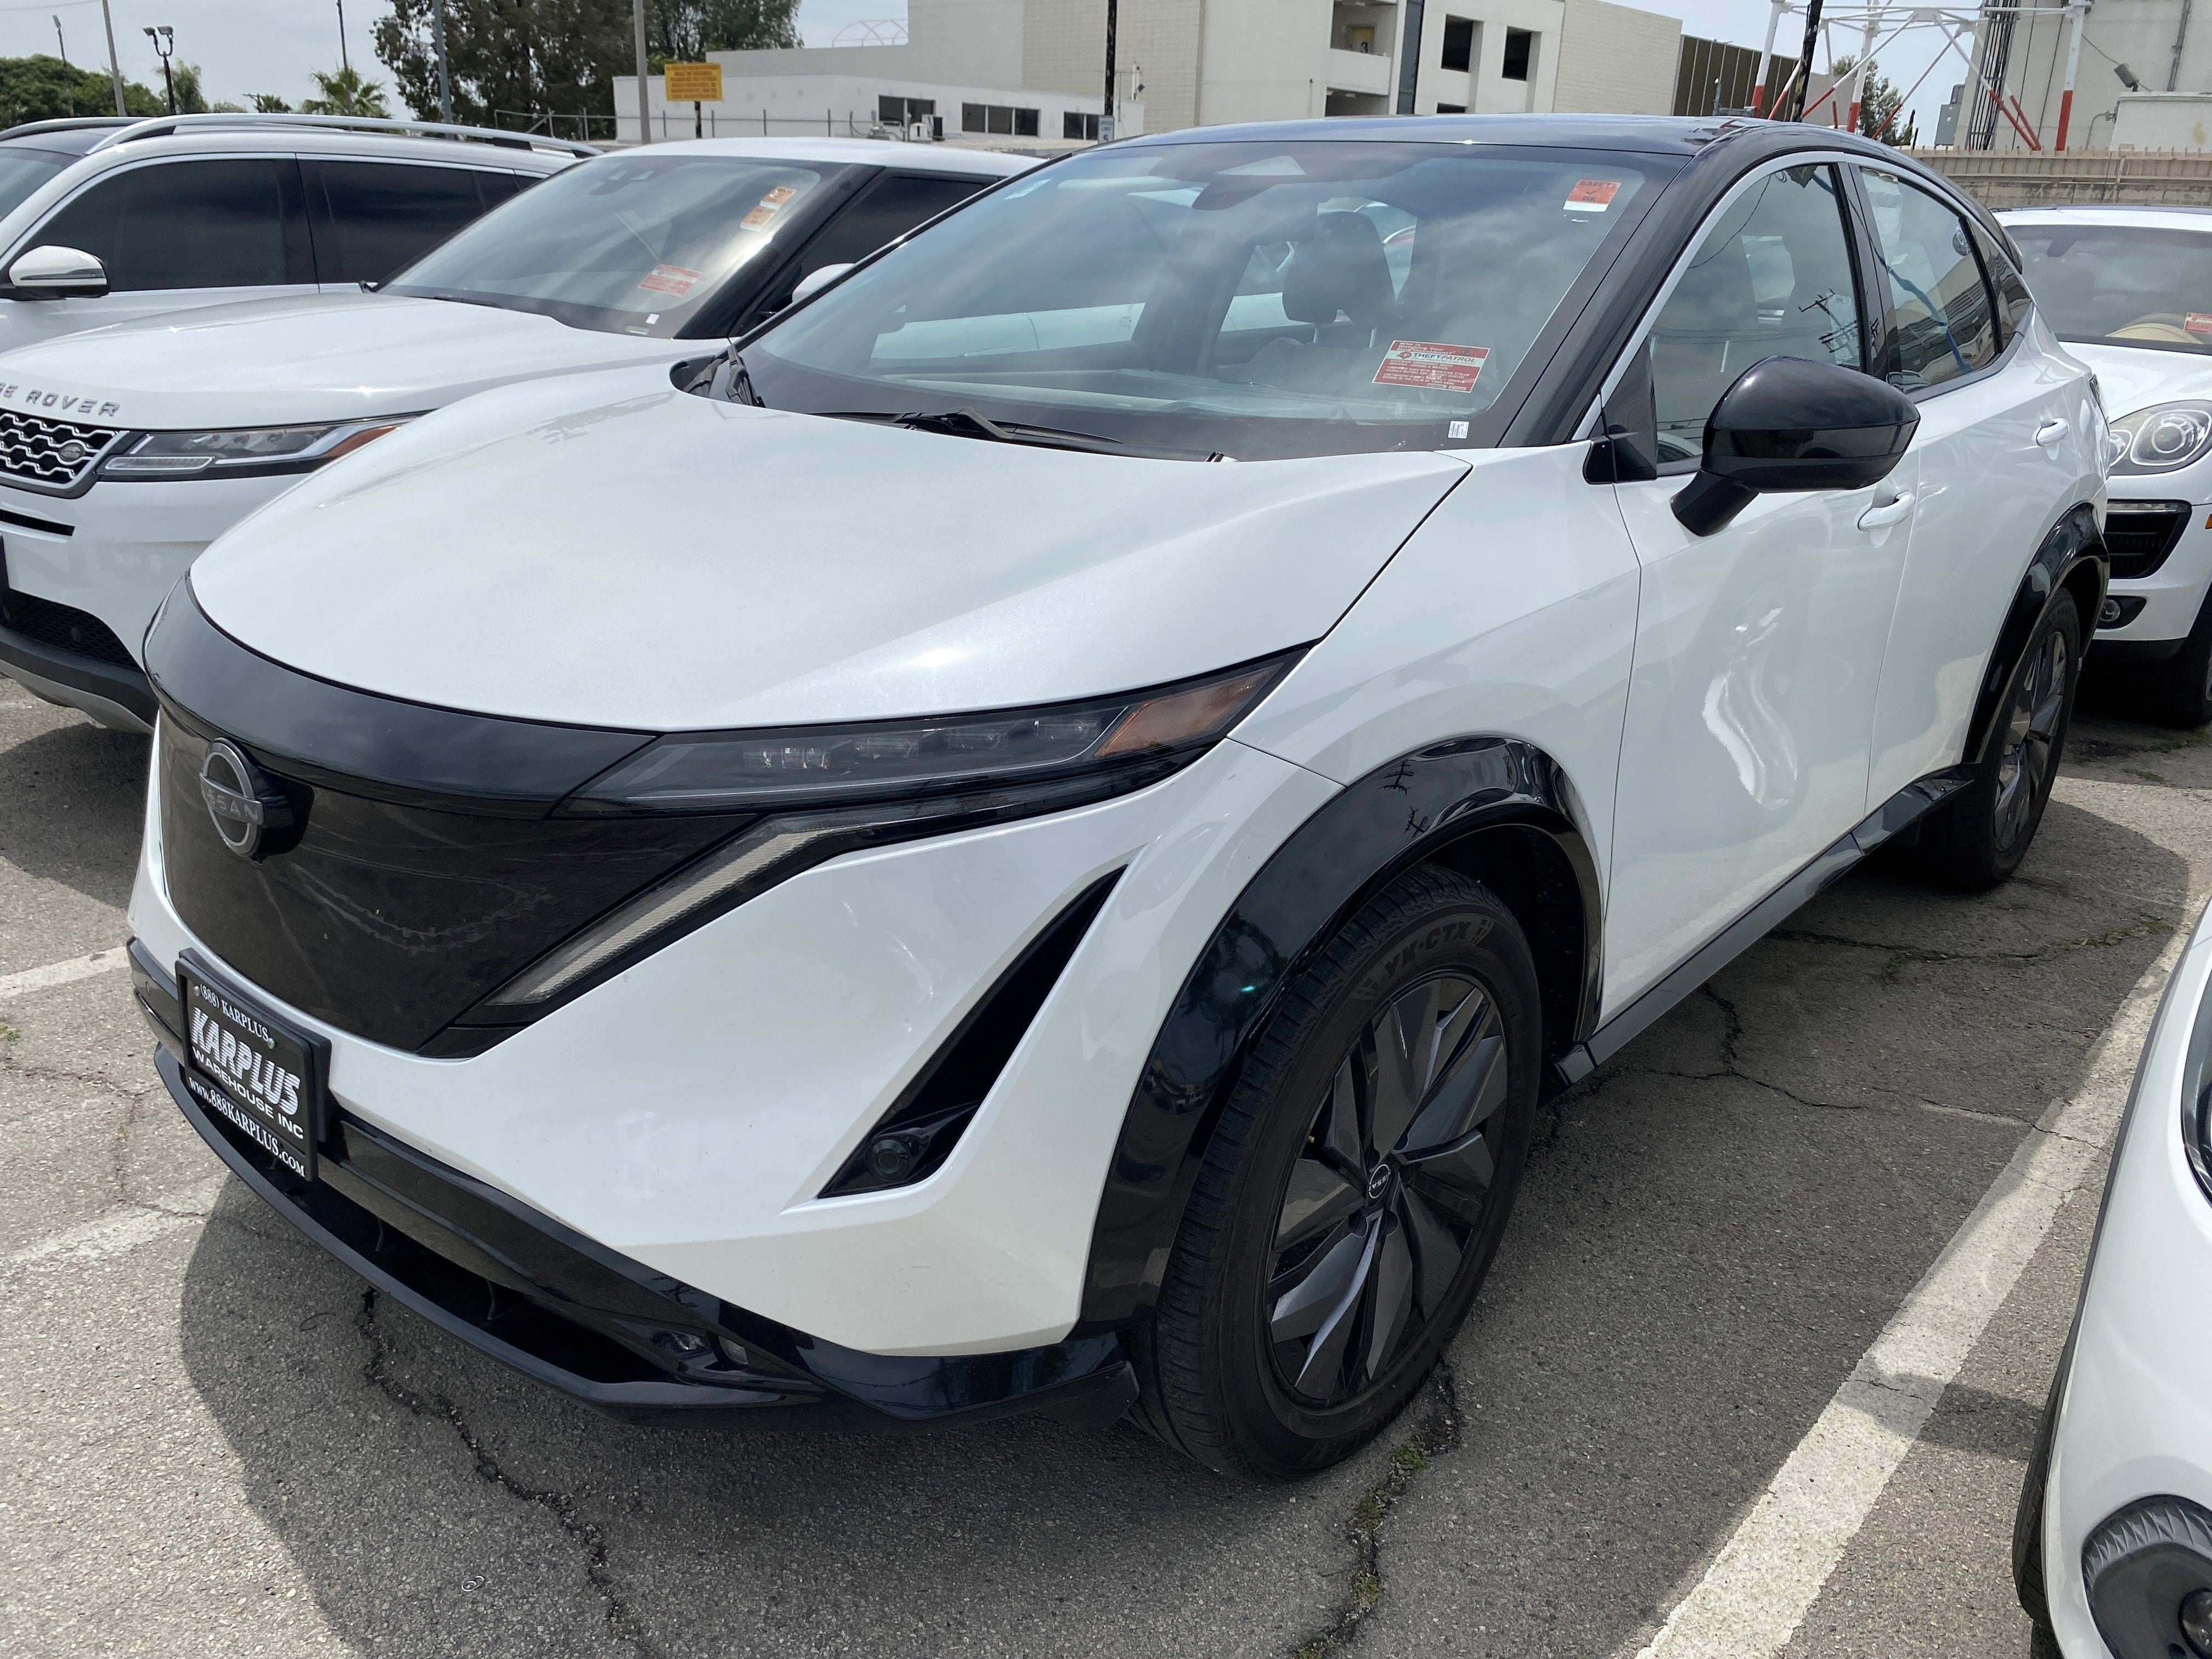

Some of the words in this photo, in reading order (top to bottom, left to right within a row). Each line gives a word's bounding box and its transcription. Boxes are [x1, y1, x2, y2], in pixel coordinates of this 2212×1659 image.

[26, 389, 121, 417] ROVER
[200, 984, 219, 1008] (888)
[221, 999, 269, 1042] KARPLUS
[191, 1006, 301, 1115] KARPLUS
[192, 1046, 274, 1119] WAREHOUSE
[278, 1113, 303, 1139] INC
